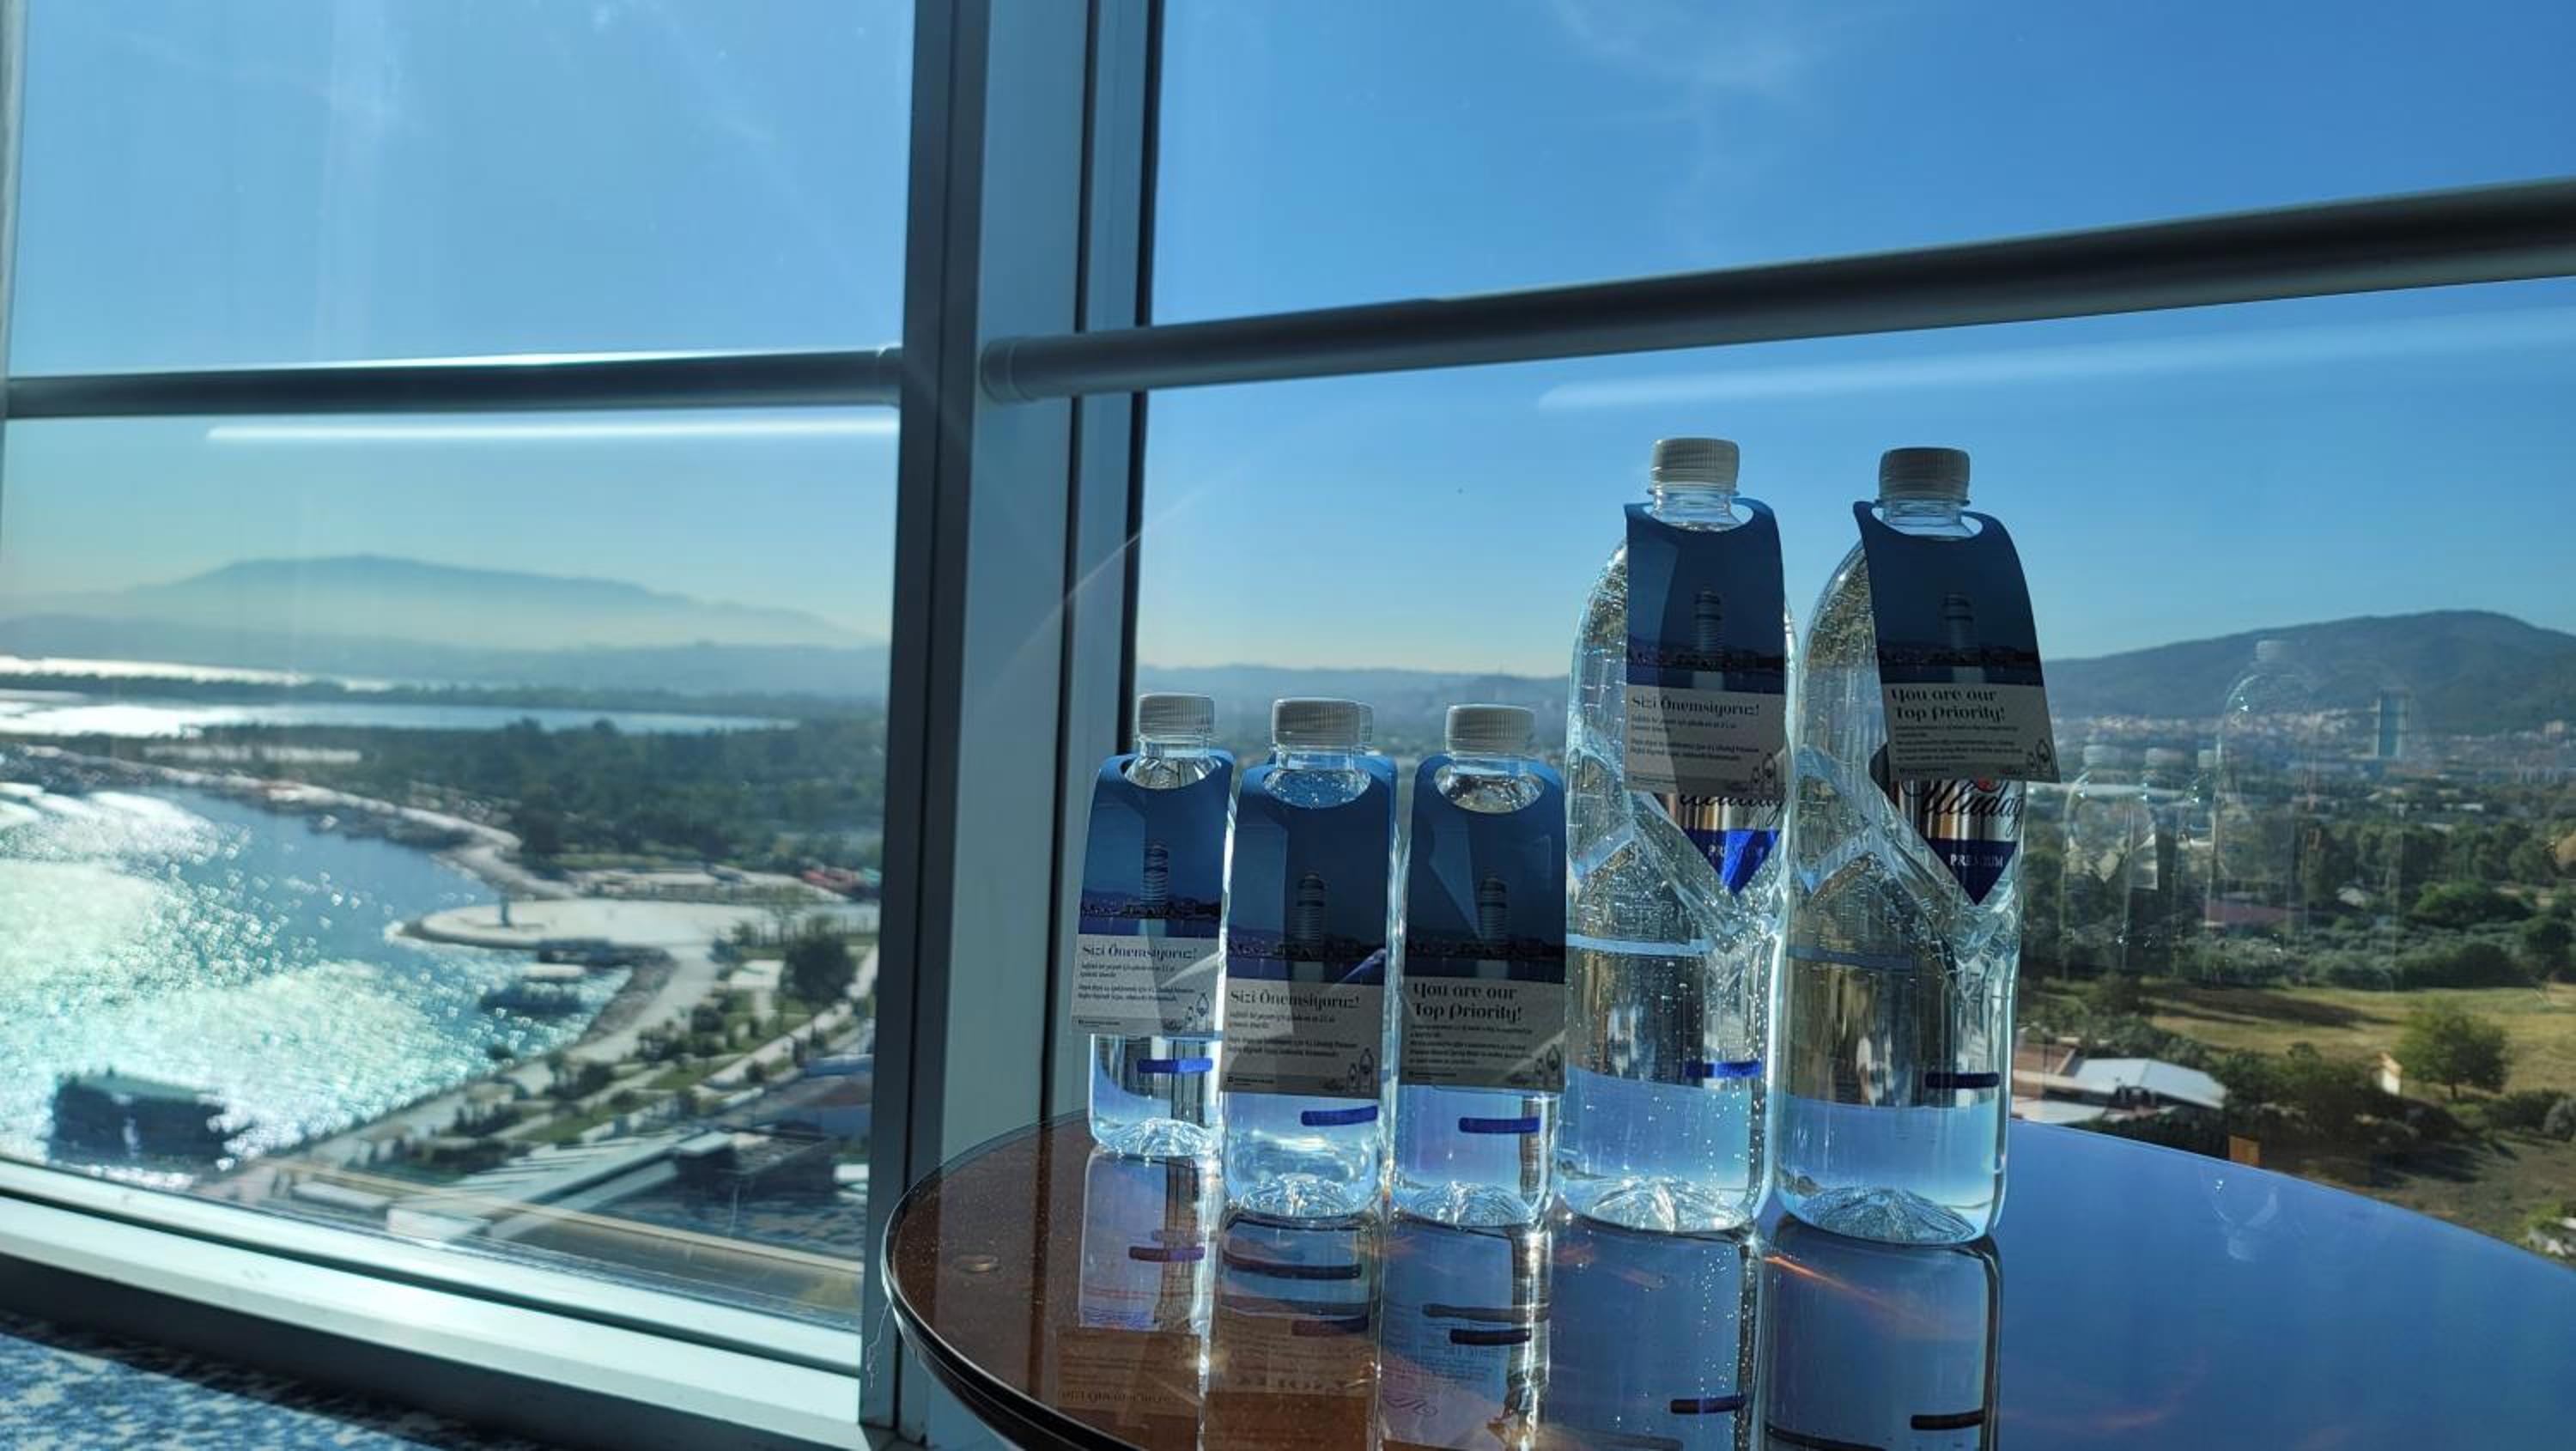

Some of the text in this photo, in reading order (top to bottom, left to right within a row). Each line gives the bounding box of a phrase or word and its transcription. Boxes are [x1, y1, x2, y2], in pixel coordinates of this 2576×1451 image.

[1631, 696, 1657, 709] Sizi
[1891, 689, 1997, 703] You are our
[1896, 706, 2006, 723] Top Priority!
[1413, 982, 1517, 1000] You are our
[1230, 989, 1360, 1011] Sizi Önemsiyoruz!
[1413, 1002, 1522, 1023] Top Priority!
